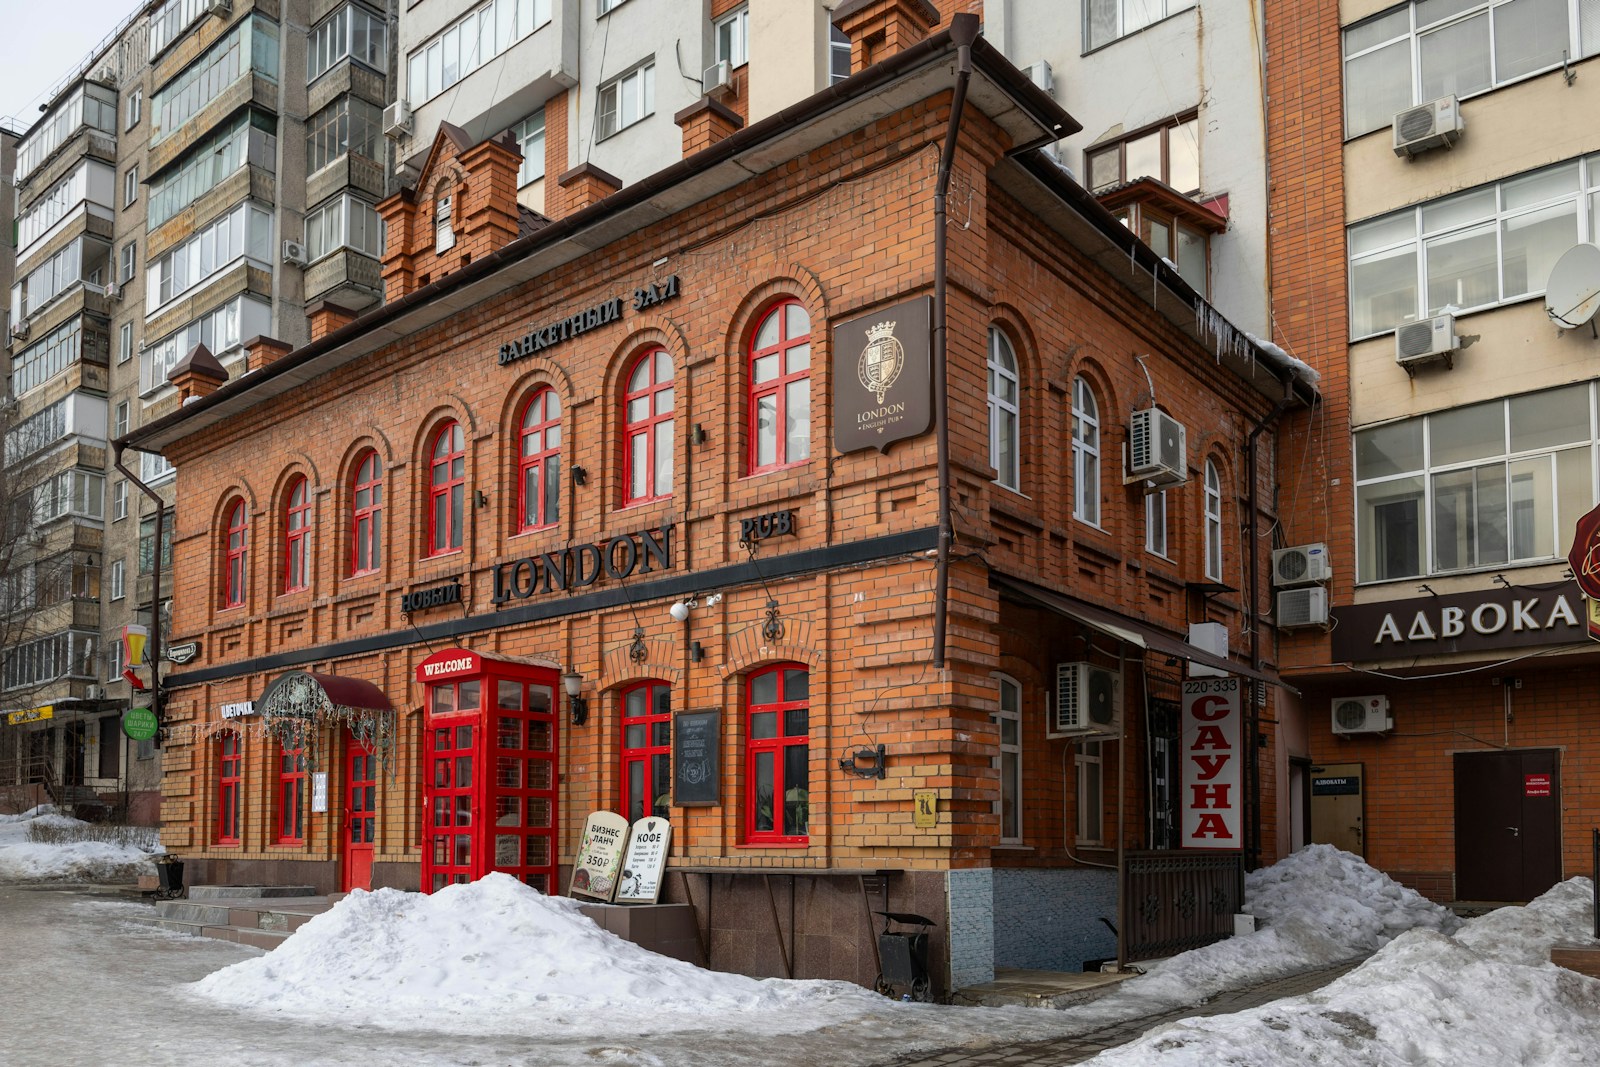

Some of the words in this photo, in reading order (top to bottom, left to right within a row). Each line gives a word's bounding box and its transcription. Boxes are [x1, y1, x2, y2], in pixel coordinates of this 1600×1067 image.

[632, 275, 679, 311] ЗАЛ
[857, 402, 905, 423] LONDON
[862, 419, 887, 430] ENGLISH
[887, 416, 900, 424] PUB
[741, 510, 792, 540] PUB
[490, 523, 676, 604] LONDON
[1374, 594, 1587, 644] АДВОКА
[424, 657, 472, 676] WELCOME
[1184, 680, 1237, 694] 220-333
[127, 720, 154, 728] ШАРИКИ
[1190, 695, 1233, 839] САУНА
[591, 824, 620, 838] БИЗНЕС
[592, 834, 614, 846] ЛАНЧ
[636, 833, 662, 843] КОФЕ
